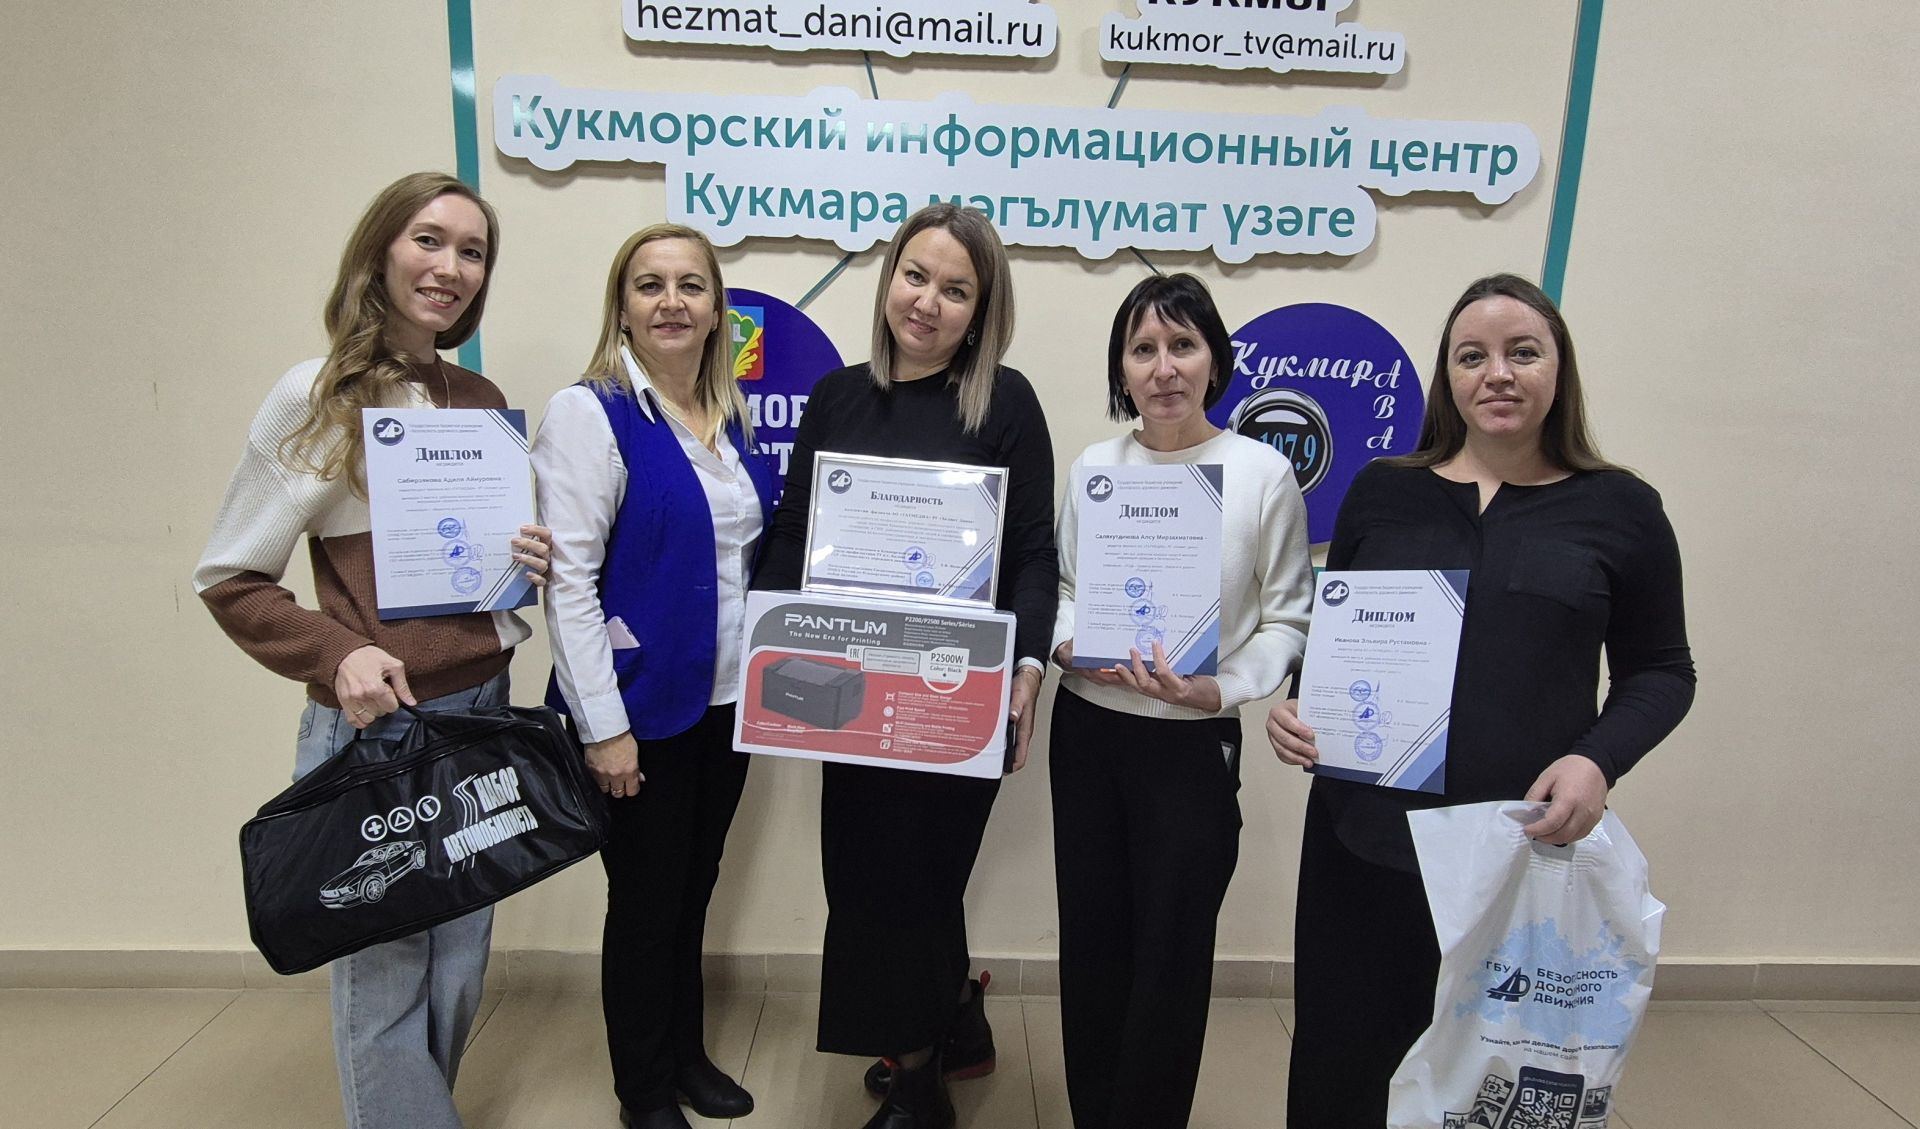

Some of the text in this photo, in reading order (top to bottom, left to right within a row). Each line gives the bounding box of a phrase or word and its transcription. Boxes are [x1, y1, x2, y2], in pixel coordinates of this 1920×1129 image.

[637, 0, 1043, 46] hezmat_dani@mail.ru
[1109, 25, 1396, 61] kukmor_tv@mail.ru
[511, 94, 1519, 186] Кукморский информационный центр
[685, 172, 908, 232] Кукмара
[1223, 203, 1356, 245] үзәге
[416, 447, 483, 462] Диплом
[1119, 504, 1179, 519] Диплом
[784, 613, 888, 636] PANTUM
[1352, 608, 1416, 623] Диплом
[851, 637, 881, 646] Printing
[930, 652, 964, 664] P2500W
[473, 766, 522, 813] НАБОР
[442, 804, 539, 864] АВТОМОБИЛИСТА
[1486, 960, 1511, 974] ГБУ
